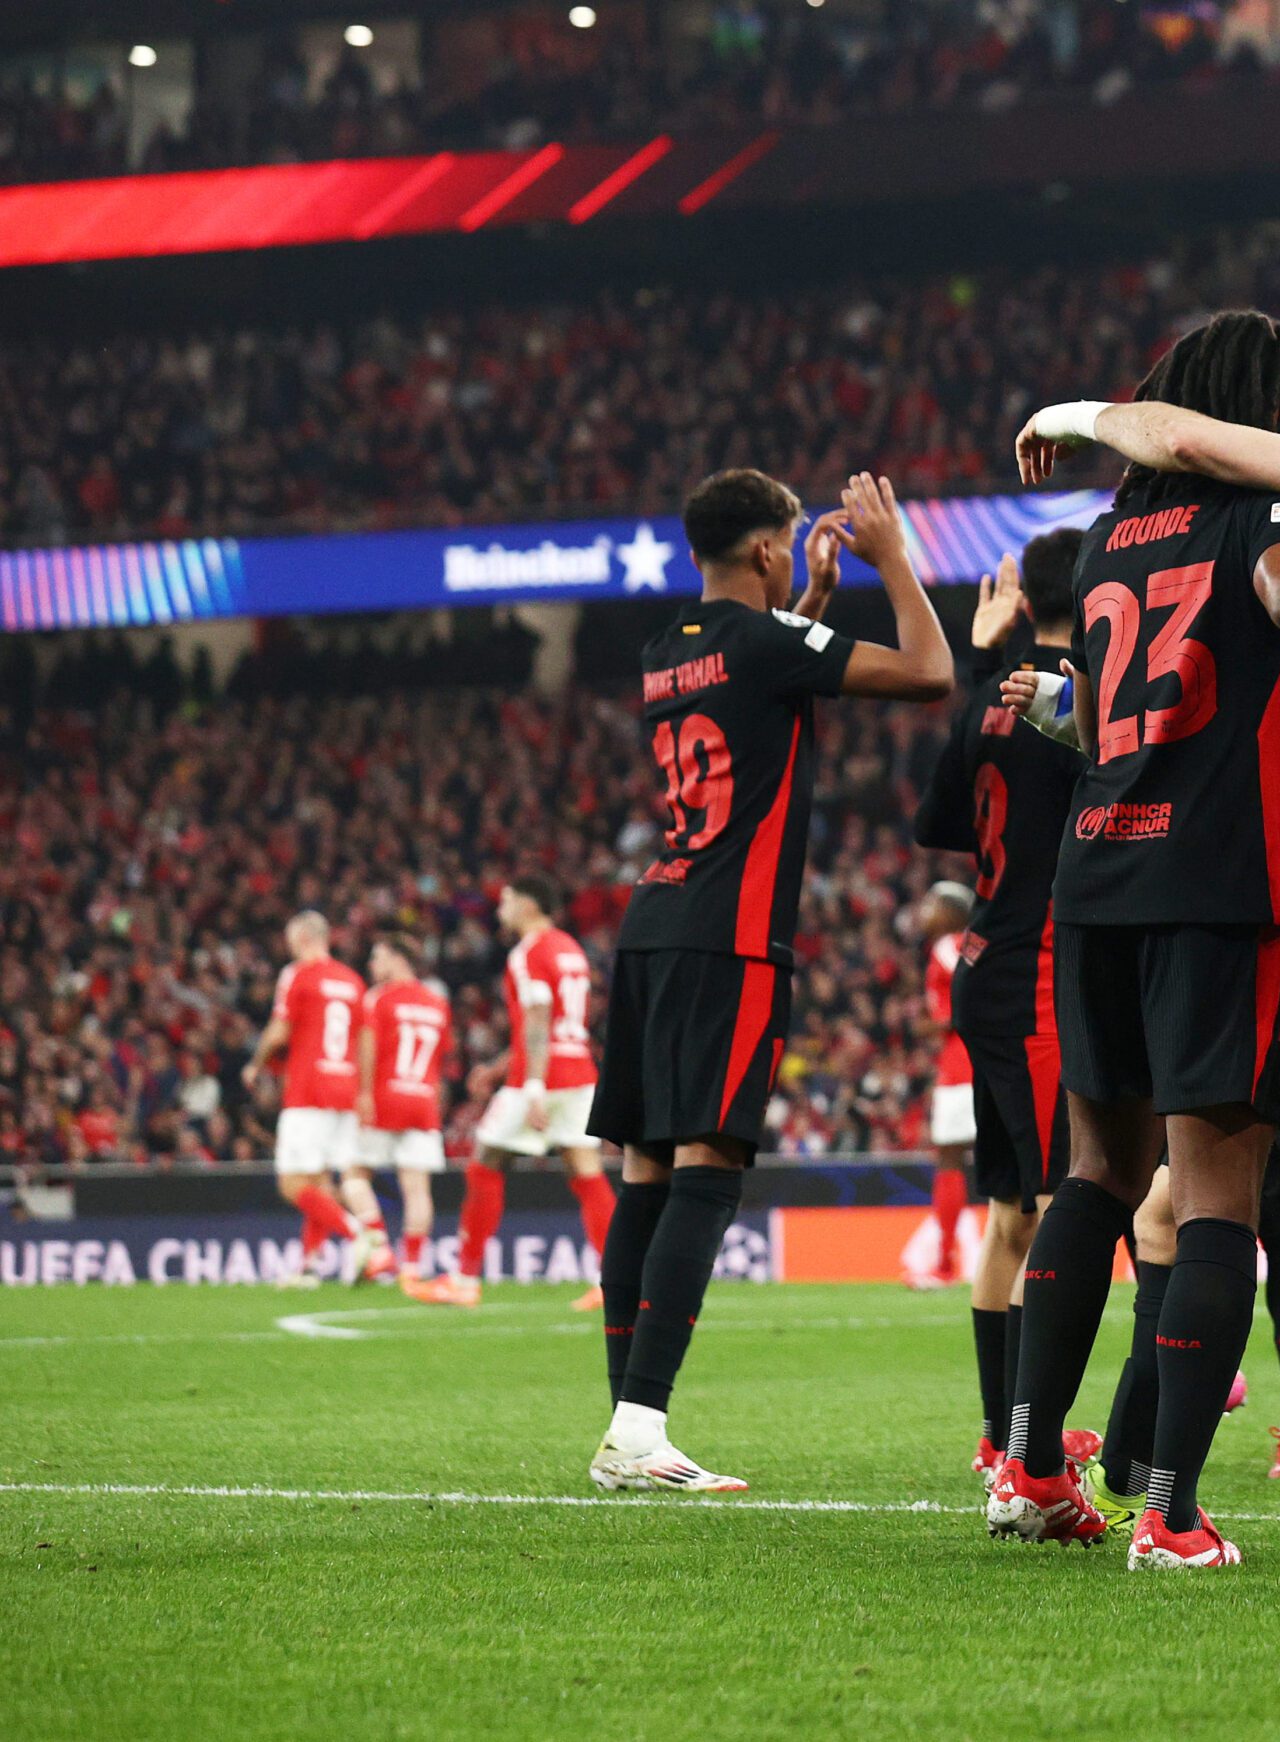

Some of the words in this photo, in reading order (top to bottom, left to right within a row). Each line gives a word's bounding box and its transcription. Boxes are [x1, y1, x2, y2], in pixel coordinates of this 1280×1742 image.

[1105, 504, 1200, 552] KOUNDE
[1083, 559, 1218, 766] 23
[652, 713, 735, 850] 19
[1103, 816, 1170, 835] ACNUR
[1107, 802, 1172, 819] UNHCR
[395, 1023, 439, 1084] 17
[0, 1239, 136, 1286] UEFA
